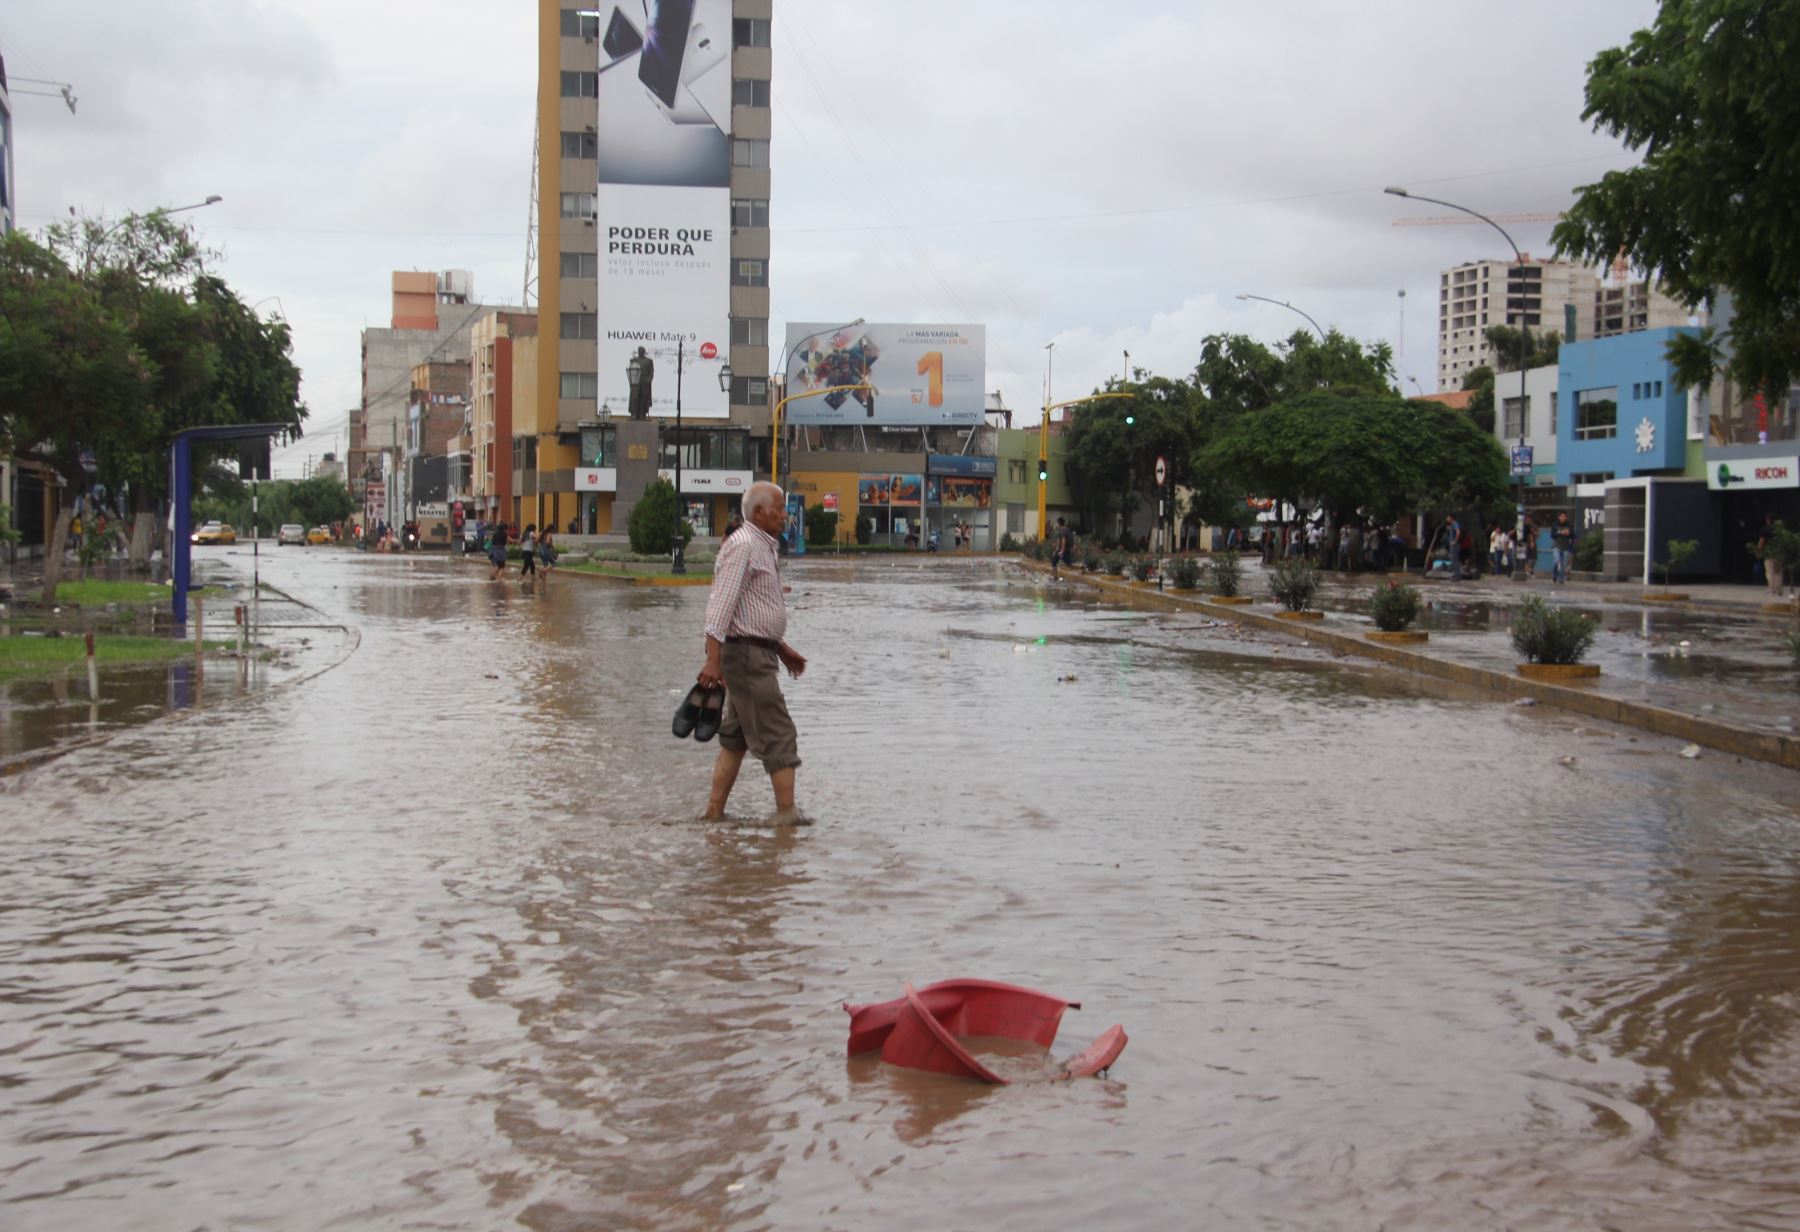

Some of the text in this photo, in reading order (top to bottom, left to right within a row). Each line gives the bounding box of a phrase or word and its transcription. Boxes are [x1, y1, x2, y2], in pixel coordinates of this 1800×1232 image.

[608, 226, 713, 242] PODER QUE
[608, 241, 695, 256] PERDURA
[636, 259, 670, 267] incluso
[674, 259, 711, 269] después
[608, 267, 666, 277] de 18 meses
[607, 330, 697, 342] HUAWEI Mate 9
[1754, 466, 1788, 480] RICOH
